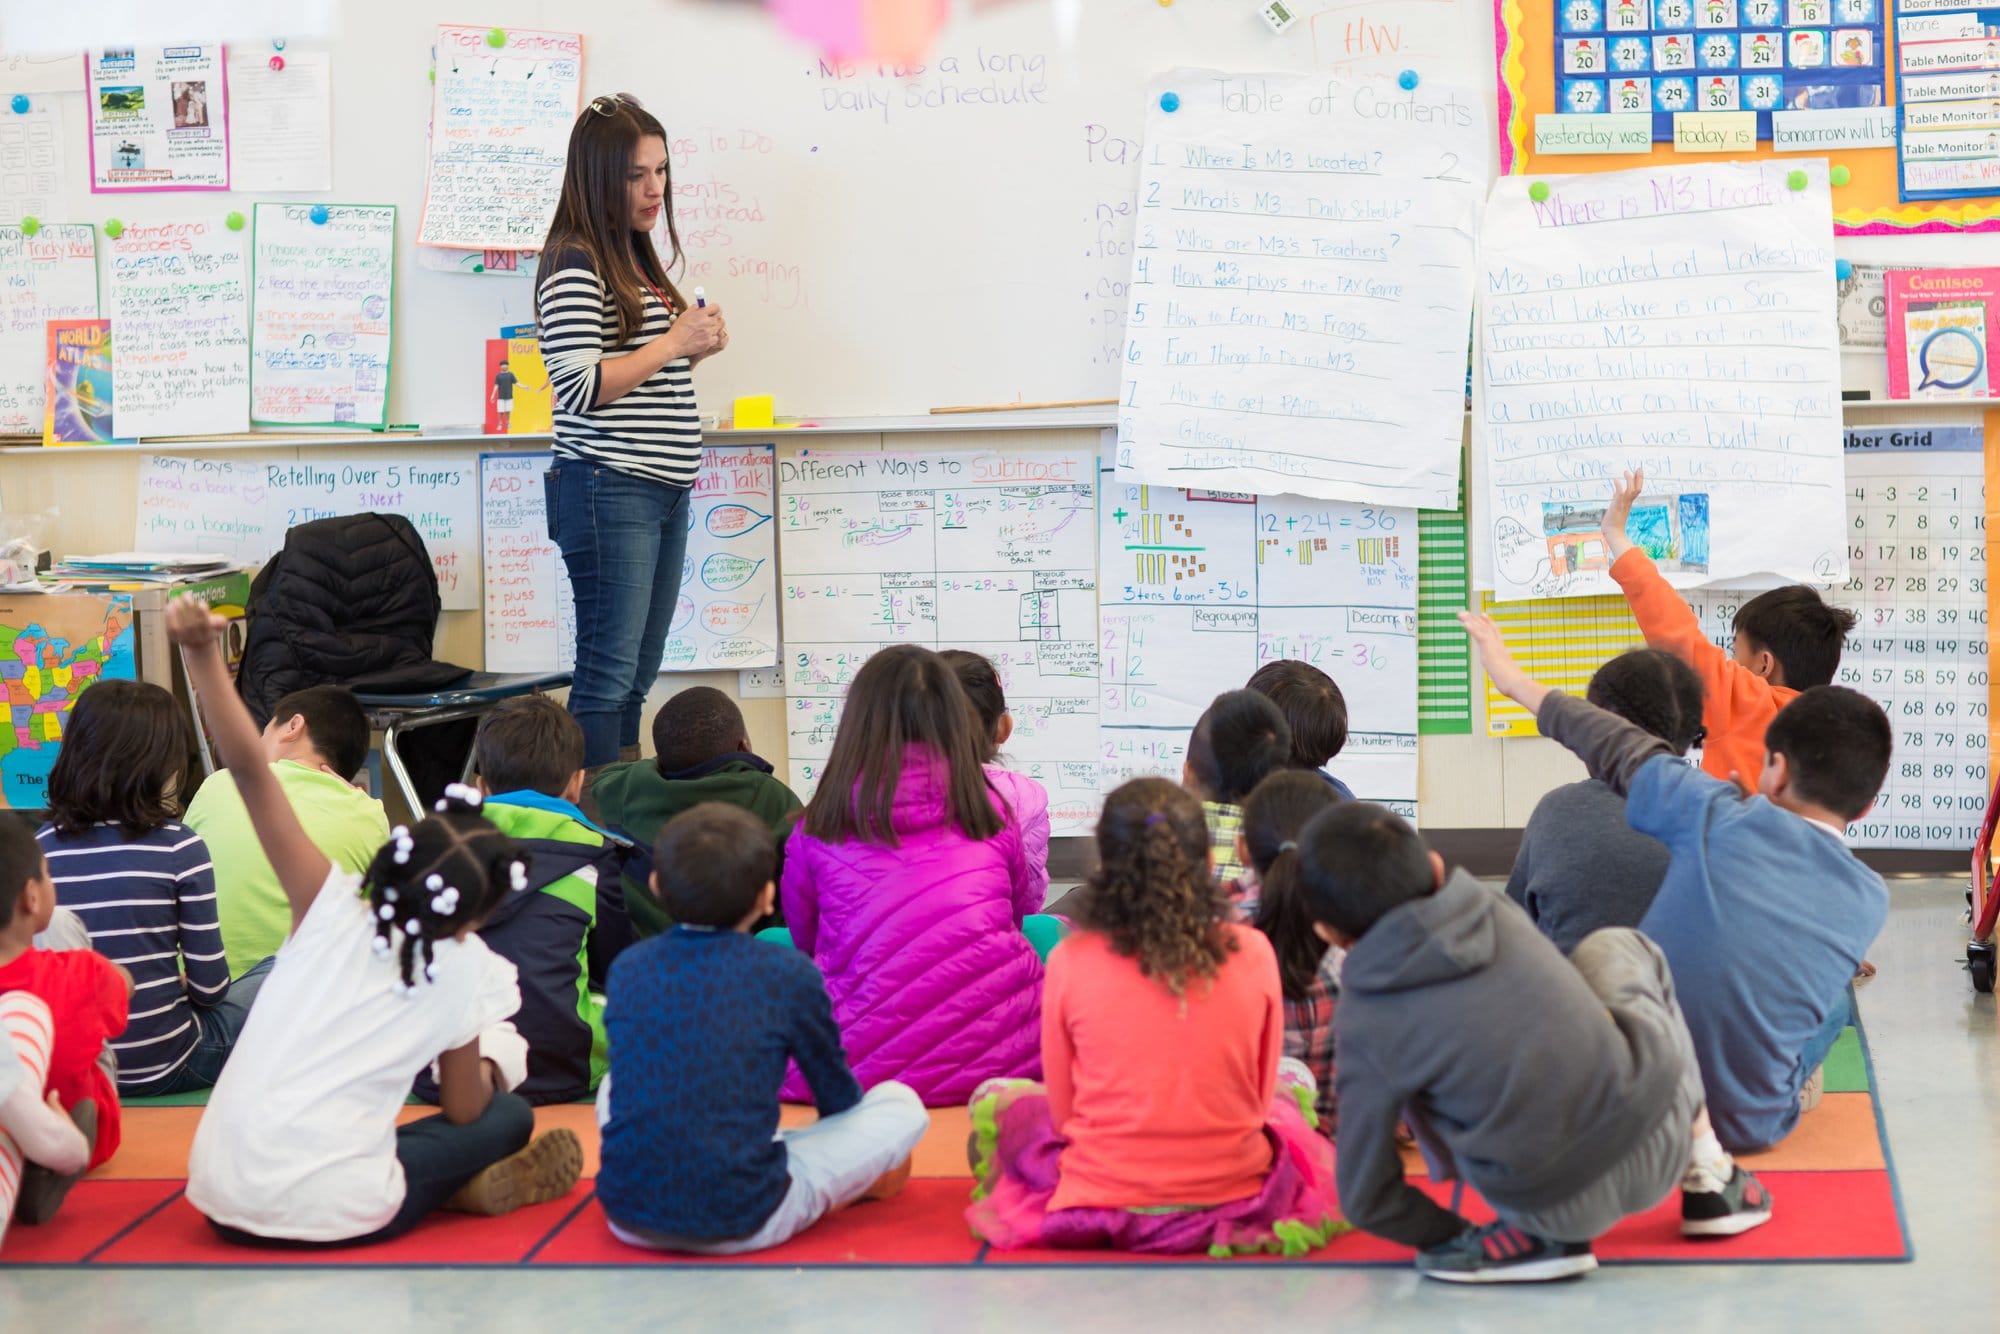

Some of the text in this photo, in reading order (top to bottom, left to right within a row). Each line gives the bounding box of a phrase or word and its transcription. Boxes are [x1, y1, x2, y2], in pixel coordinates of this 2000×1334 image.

[1576, 0, 1861, 26] 13 14 15 16 17 18 19
[939, 47, 1046, 80] a long
[1577, 46, 1770, 69] 20 21 22 23 24
[1904, 53, 1983, 68] Table Monitor
[1576, 87, 1770, 108] 27 28 29 30 31
[1907, 83, 1985, 98] Table Monitor
[822, 79, 1050, 124] Daily Schedule
[1213, 78, 1473, 127] Table of Contents
[1909, 110, 1987, 124] Table Monitor
[1536, 123, 1648, 146] yesterday was
[1678, 124, 1750, 145] today is
[1775, 117, 1898, 142] tomorrow will be
[1186, 144, 1294, 169] Where Is M3
[1905, 140, 1983, 155] Table Monitor
[1256, 192, 1282, 214] M3
[1531, 176, 1695, 227] Where is M3
[61, 225, 88, 243] Help
[1176, 227, 1212, 250] Who
[1224, 239, 1251, 251] are
[1173, 263, 1203, 288] How
[1488, 249, 1699, 294] M3 is located at
[1490, 279, 1789, 326] school Lakeshore is in San
[1167, 302, 1198, 327] How
[1282, 312, 1309, 332] M3
[1323, 314, 1367, 343] Frogs
[60, 326, 101, 347] WORLD
[1604, 320, 1728, 348] M3 not
[1166, 337, 1355, 372] Fun Things M3
[141, 362, 226, 383] you know how
[1486, 354, 1585, 384] Lakeshore
[1704, 353, 1748, 382] but
[1490, 399, 1511, 422] a
[1529, 386, 1624, 420] modular
[1490, 416, 1763, 453] The modular was built
[1843, 431, 1932, 448] ber Grid
[780, 456, 1078, 482] Different Ways to Subtract
[1688, 459, 1717, 477] us
[267, 465, 461, 491] Retelling Over 5 Fingers
[488, 477, 522, 492] ADD
[730, 467, 772, 490] Talk!
[370, 492, 404, 507] Next
[787, 496, 810, 512] 36
[419, 514, 452, 526] After
[1357, 509, 1397, 530] 36
[1950, 515, 1959, 529] 9
[429, 528, 454, 540] that
[1848, 546, 1959, 560] 16 19
[500, 562, 535, 573] total
[499, 576, 531, 586] sum
[1874, 576, 1958, 592] 27 29
[1218, 582, 1248, 600] 36
[500, 607, 527, 618] add
[1195, 610, 1258, 627] Regrouping
[1874, 608, 1895, 624] 37
[501, 619, 556, 630] increased
[505, 632, 520, 643] by
[1351, 644, 1386, 670] 36
[1904, 640, 1988, 656] 48 50
[1054, 698, 1091, 707] Number
[1903, 700, 1988, 717] 68 70
[1362, 736, 1393, 747] Number
[1934, 732, 1955, 748] 79
[16, 774, 43, 784] The
[1965, 764, 1986, 780] 90
[1959, 796, 1985, 810] 100
[1863, 824, 1952, 840] 107 109
